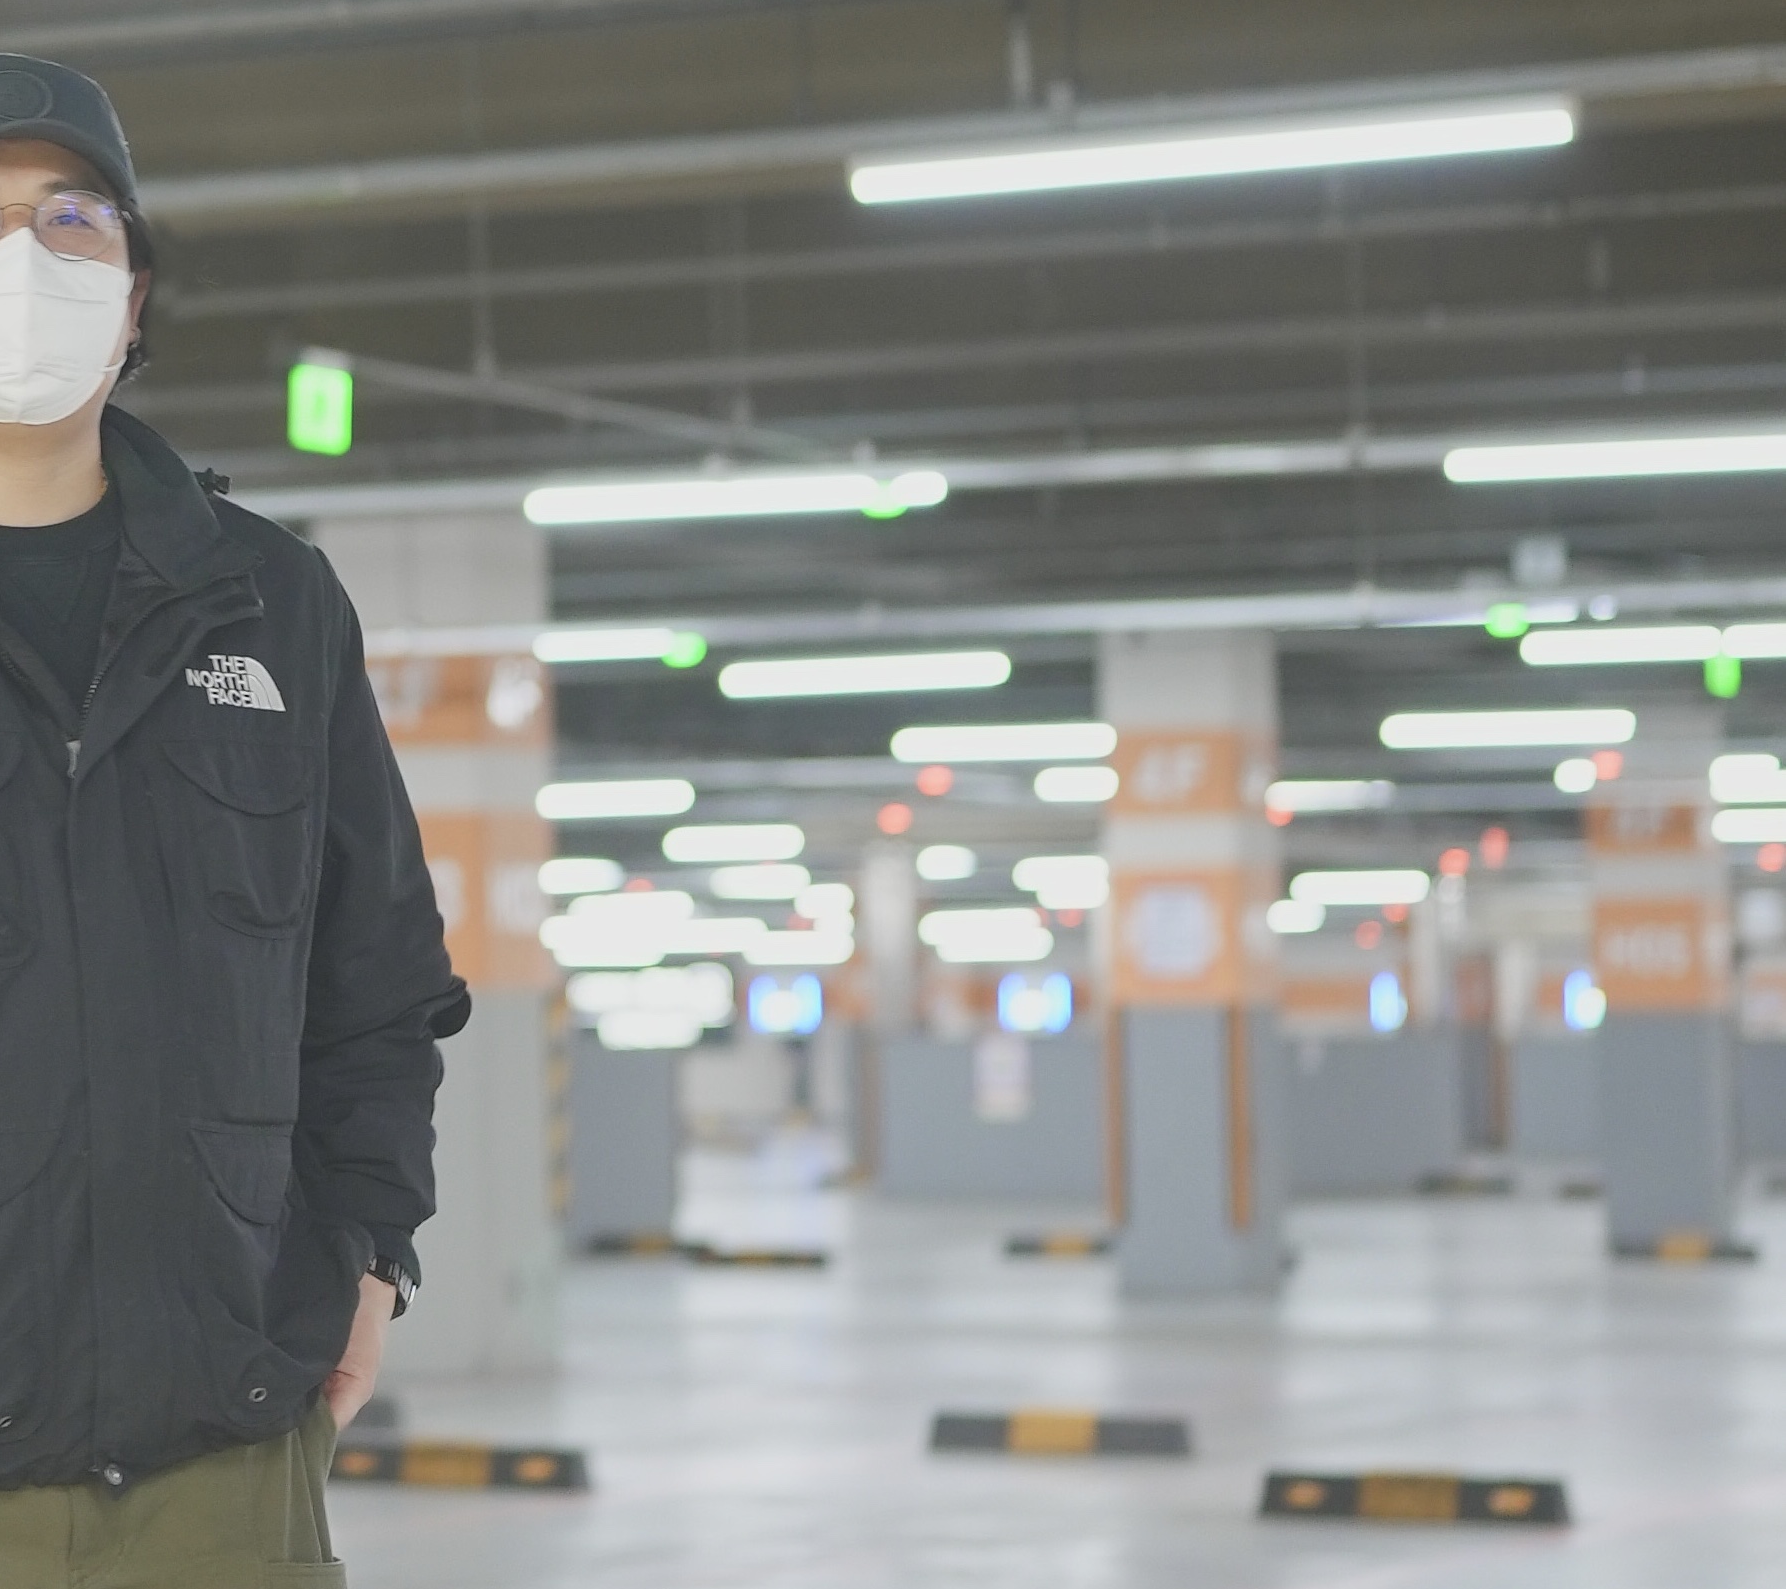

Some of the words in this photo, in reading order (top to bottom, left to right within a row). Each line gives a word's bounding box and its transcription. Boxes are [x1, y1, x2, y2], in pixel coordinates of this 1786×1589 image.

[207, 654, 248, 675] THE
[185, 668, 250, 691] NORTH
[206, 687, 253, 708] FACE
